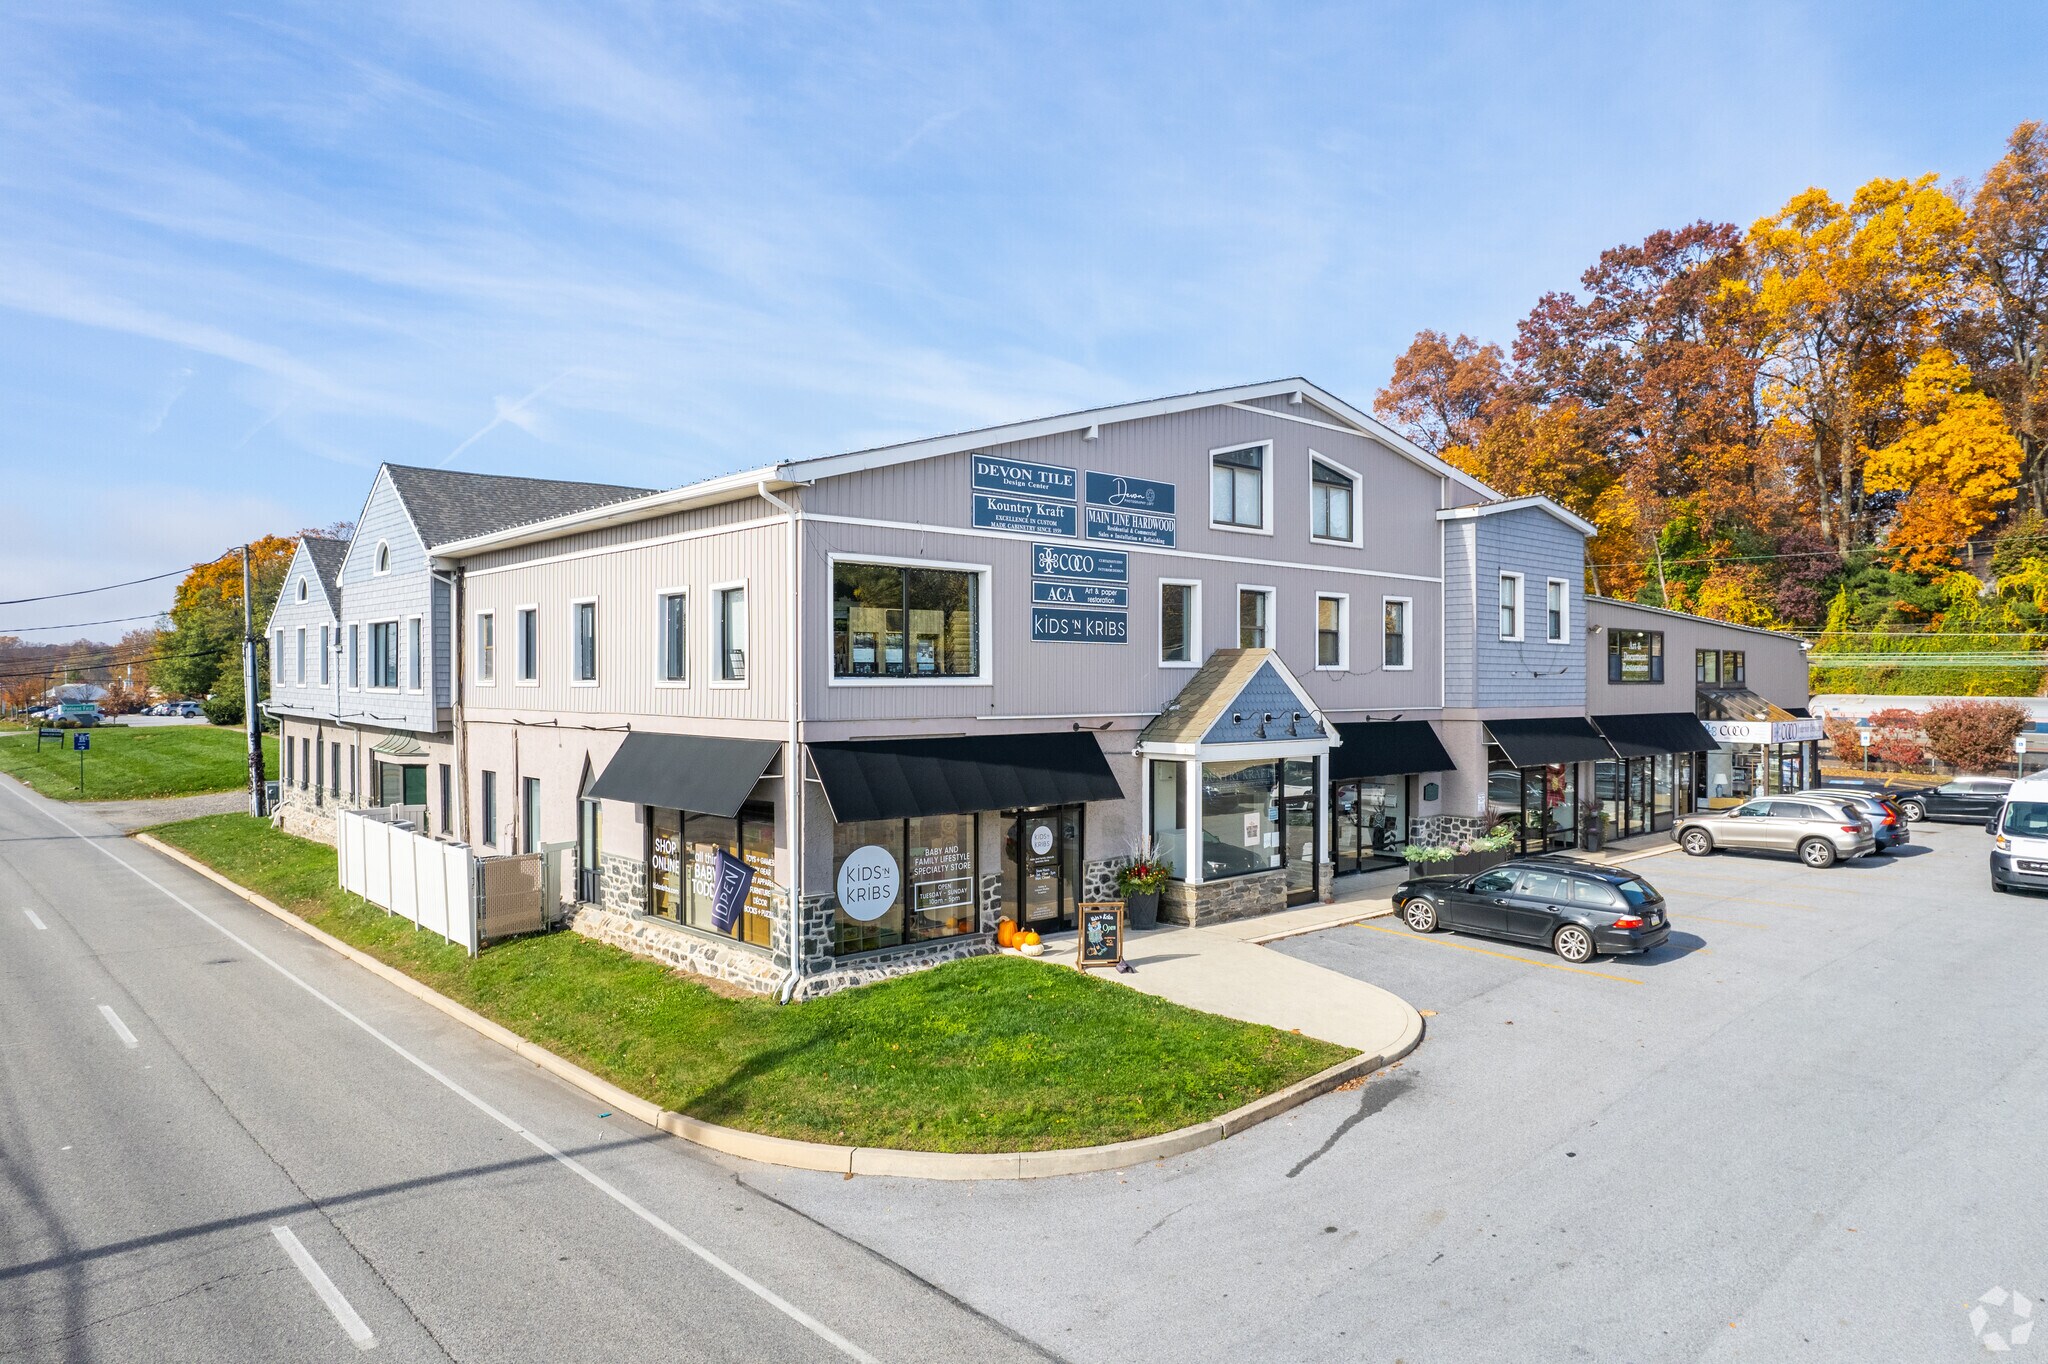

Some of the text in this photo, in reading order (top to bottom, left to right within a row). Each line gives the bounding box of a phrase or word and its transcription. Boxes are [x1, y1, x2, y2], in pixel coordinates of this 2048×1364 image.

[977, 463, 1073, 486] DEVON TILE
[1003, 478, 1049, 490] Design Center
[1108, 477, 1145, 505] Devon
[987, 498, 1065, 518] Kountry Kraft
[996, 515, 1029, 524] EXCELLENCE
[1037, 519, 1057, 527] CUSTOM
[1089, 509, 1174, 532] MAIN LINE HARDWOOD
[1008, 523, 1036, 532] CABINETRY
[1037, 525, 1051, 533] SINCE
[1107, 525, 1129, 533] Residential
[1114, 533, 1138, 541] Installation
[1059, 553, 1094, 573] COCO
[1047, 587, 1075, 602] ACA
[1101, 589, 1117, 597] paper
[1087, 596, 1115, 604] restoration
[1720, 725, 1750, 737] COCO
[655, 838, 677, 855] SHOP
[925, 845, 959, 857] BABY AND
[695, 852, 704, 863] all
[914, 853, 970, 866] FAMILY LIFESTYLE
[652, 855, 680, 875] ONLINE
[914, 861, 971, 876] SPECIALTY STORE
[692, 879, 716, 898] TODD
[715, 869, 739, 916] OPEN
[920, 890, 942, 899] TUESDAY
[928, 897, 943, 905] 10am
[1102, 923, 1116, 934] Open
